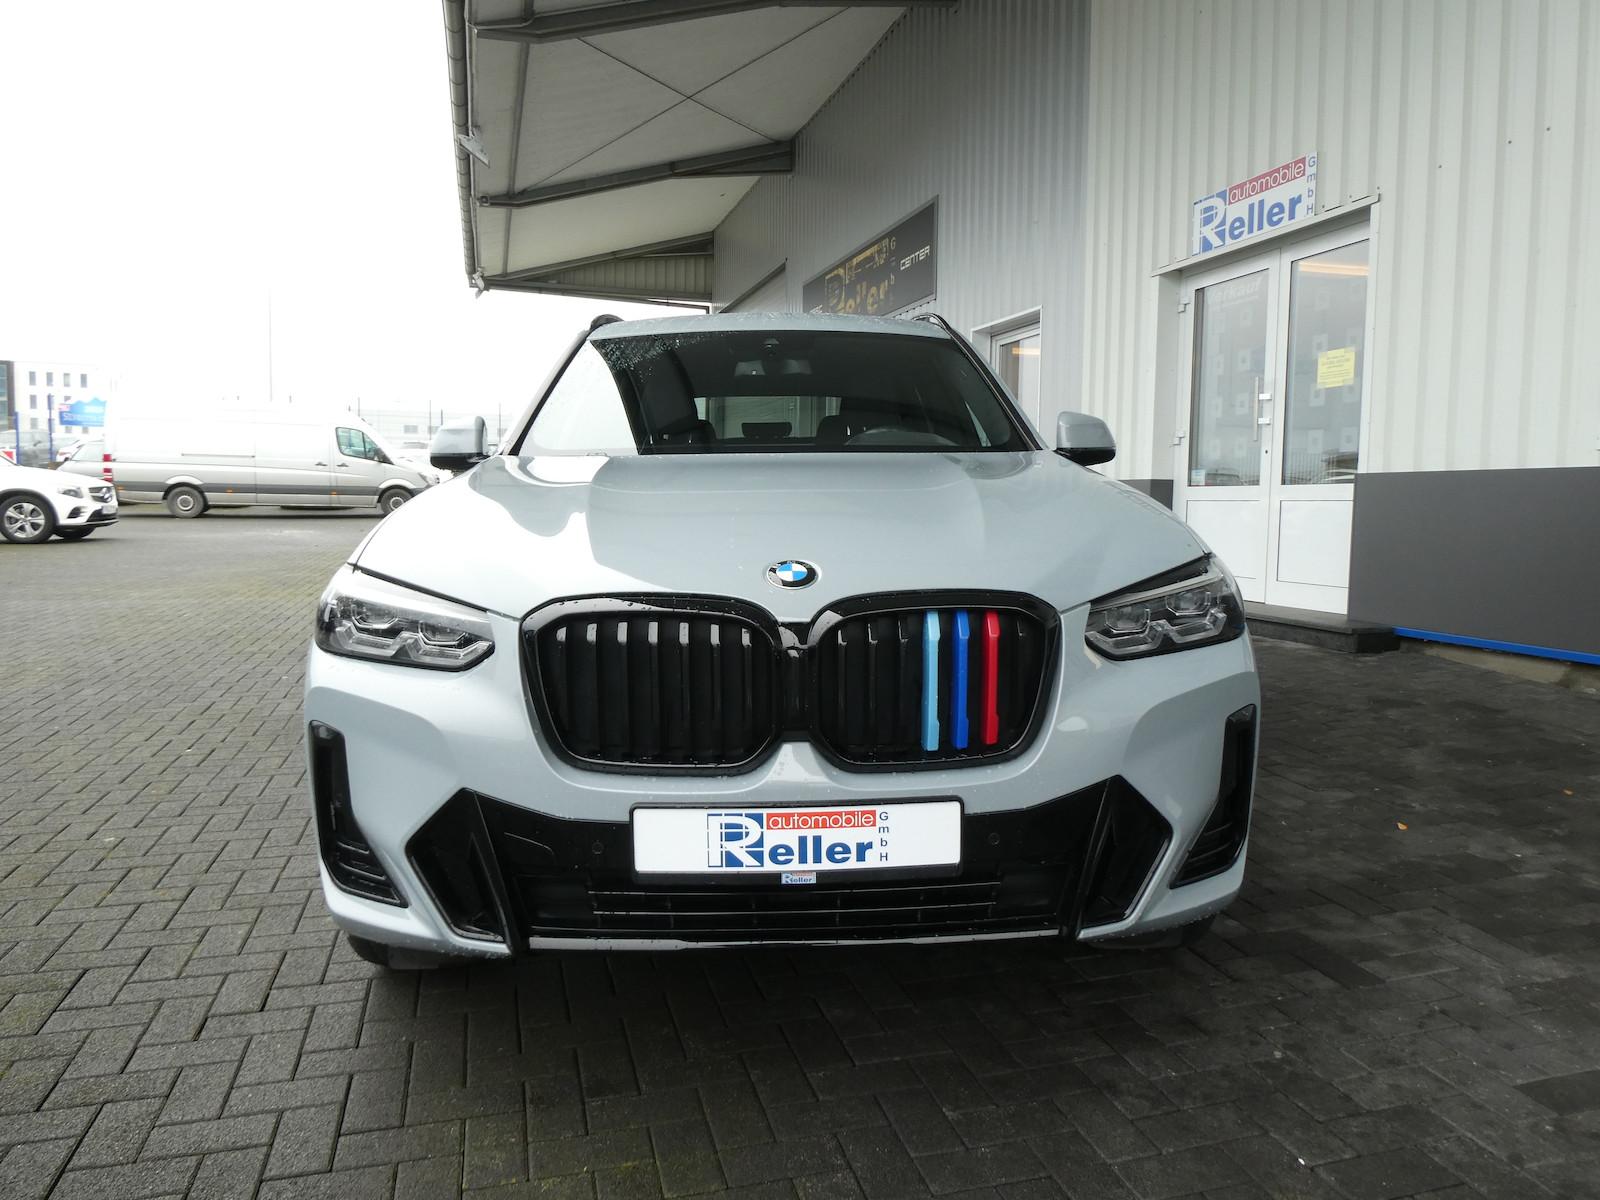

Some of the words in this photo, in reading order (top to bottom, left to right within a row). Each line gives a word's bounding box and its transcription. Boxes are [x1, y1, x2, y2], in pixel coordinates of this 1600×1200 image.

[1229, 161, 1305, 204] automobile
[1306, 156, 1316, 216] GmbH
[1192, 189, 1303, 256] Reller
[899, 245, 931, 271] CENTER
[706, 812, 874, 868] Reller
[768, 810, 875, 830] automobile
[878, 810, 890, 863] GmbH
